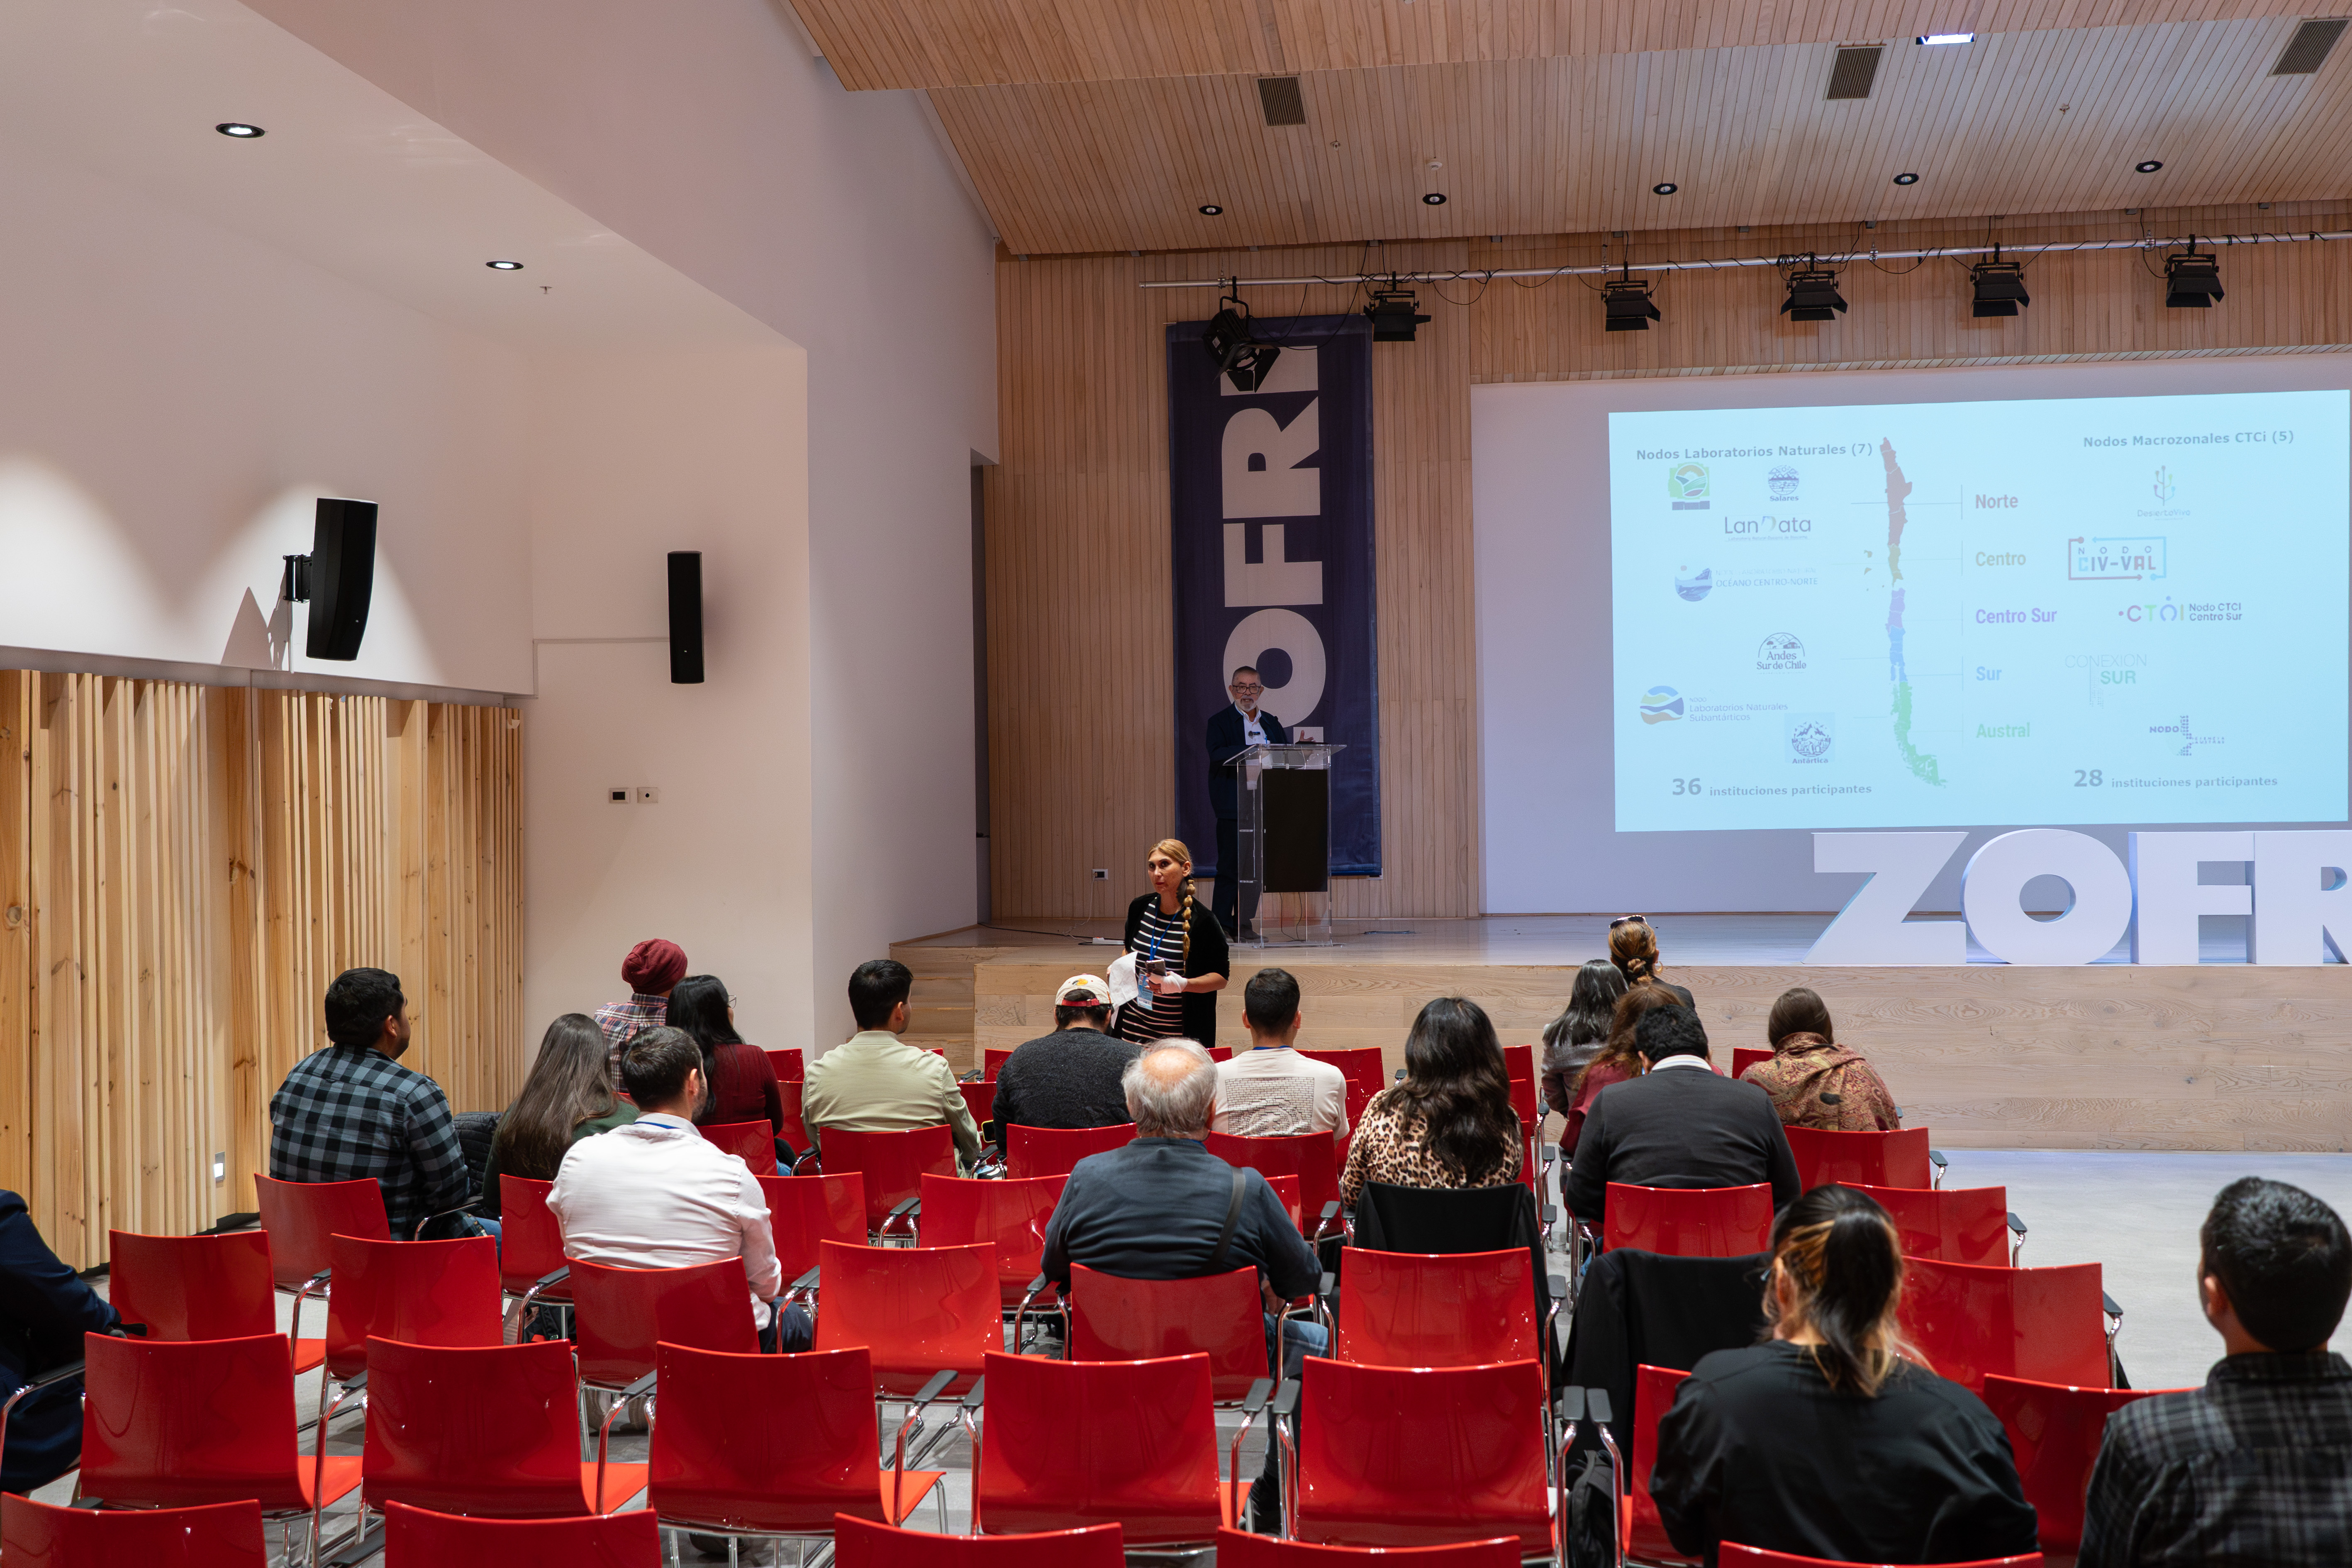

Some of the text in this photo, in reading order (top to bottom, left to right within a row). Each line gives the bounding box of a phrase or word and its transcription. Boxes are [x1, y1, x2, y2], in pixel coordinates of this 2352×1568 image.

[2084, 430, 2294, 447] Nodos Macrozonales CTCi (5)
[1637, 443, 1872, 460] Nodos Laboratorios Naturales (7)
[1975, 494, 2018, 509] Norte
[1975, 551, 2026, 567] Centro
[2079, 555, 2156, 572] CIV-VAL
[1716, 578, 1818, 588] OCÉANO CENTRO-NORTE
[2189, 603, 2216, 612] Nodo
[1975, 607, 2057, 624] Centro Sur
[2189, 612, 2242, 622] Centro Sur
[1766, 650, 1797, 661] Andes
[1756, 660, 1807, 670] Sur de Chile
[1976, 666, 2002, 681] Sur
[2100, 670, 2136, 685] SUR
[1689, 704, 1744, 712] Laboratorios
[1689, 713, 1750, 722] Subantárticos
[1976, 722, 2030, 738] Austral
[2074, 769, 2278, 788] 28 instituciones participantes
[1672, 778, 1872, 797] 36 instituciones participantes
[1801, 829, 2352, 964] ZOFR
